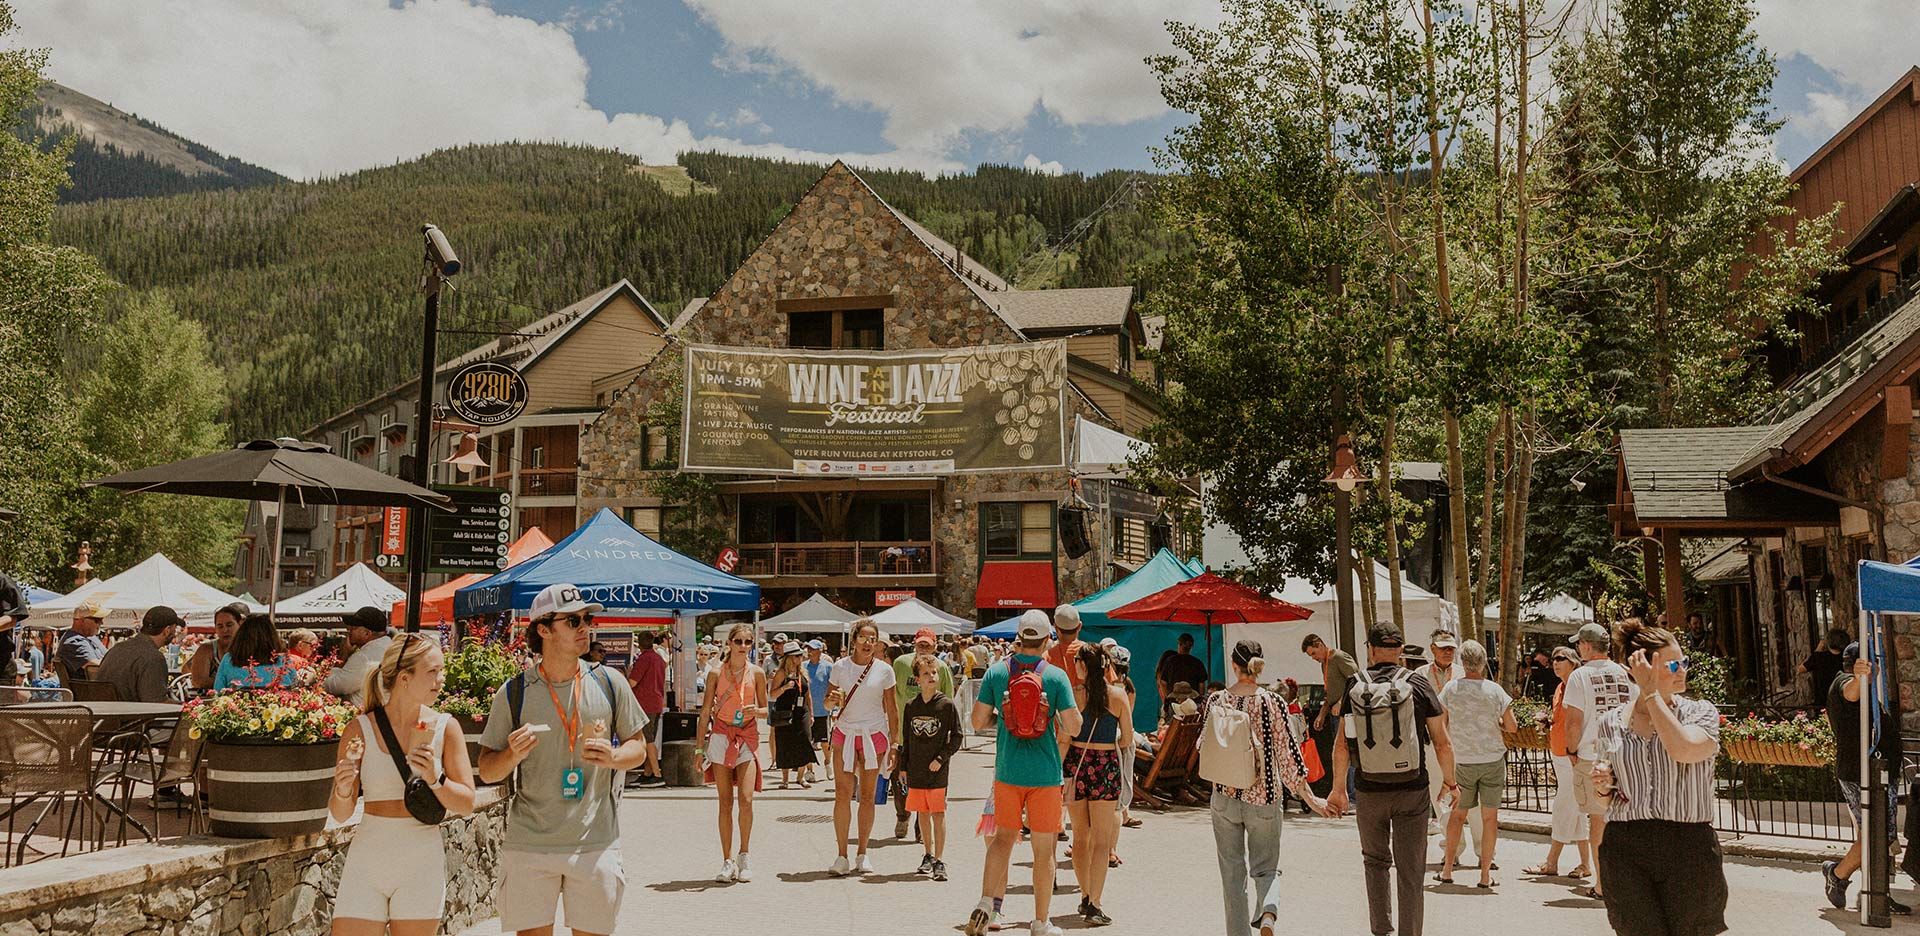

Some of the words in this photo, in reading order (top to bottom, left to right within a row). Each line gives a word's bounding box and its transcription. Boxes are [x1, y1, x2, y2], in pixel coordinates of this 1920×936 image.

[700, 360, 733, 373] JULY
[739, 362, 778, 375] 16-17
[700, 374, 725, 385] 1PM
[735, 376, 762, 388] 5PM
[788, 364, 869, 405] WINE
[889, 364, 963, 405] JAZZ
[704, 402, 733, 411] GRAND
[736, 404, 760, 413] WINE
[465, 410, 480, 420] TAP
[481, 411, 511, 422] HOUSE
[703, 410, 738, 418] TASTING
[825, 401, 926, 427] Festival
[703, 420, 720, 428] LIVE
[723, 421, 744, 429] JAZZ
[746, 423, 773, 431] MUSIC
[780, 427, 826, 435] PERFORMANCES
[702, 430, 743, 439] GOURMET
[746, 432, 769, 440] FOOD
[701, 438, 741, 446] VENDORS
[794, 449, 819, 457] RIVER
[892, 450, 939, 458] KEYSTONE,
[389, 507, 401, 536] KEYSTO
[453, 531, 463, 539] Adult
[484, 545, 494, 553] Shop
[570, 549, 673, 561] KINDRED
[458, 558, 470, 567] Village
[471, 558, 483, 566] Events
[719, 550, 739, 572] AR
[580, 584, 709, 605] OCKRESORTS
